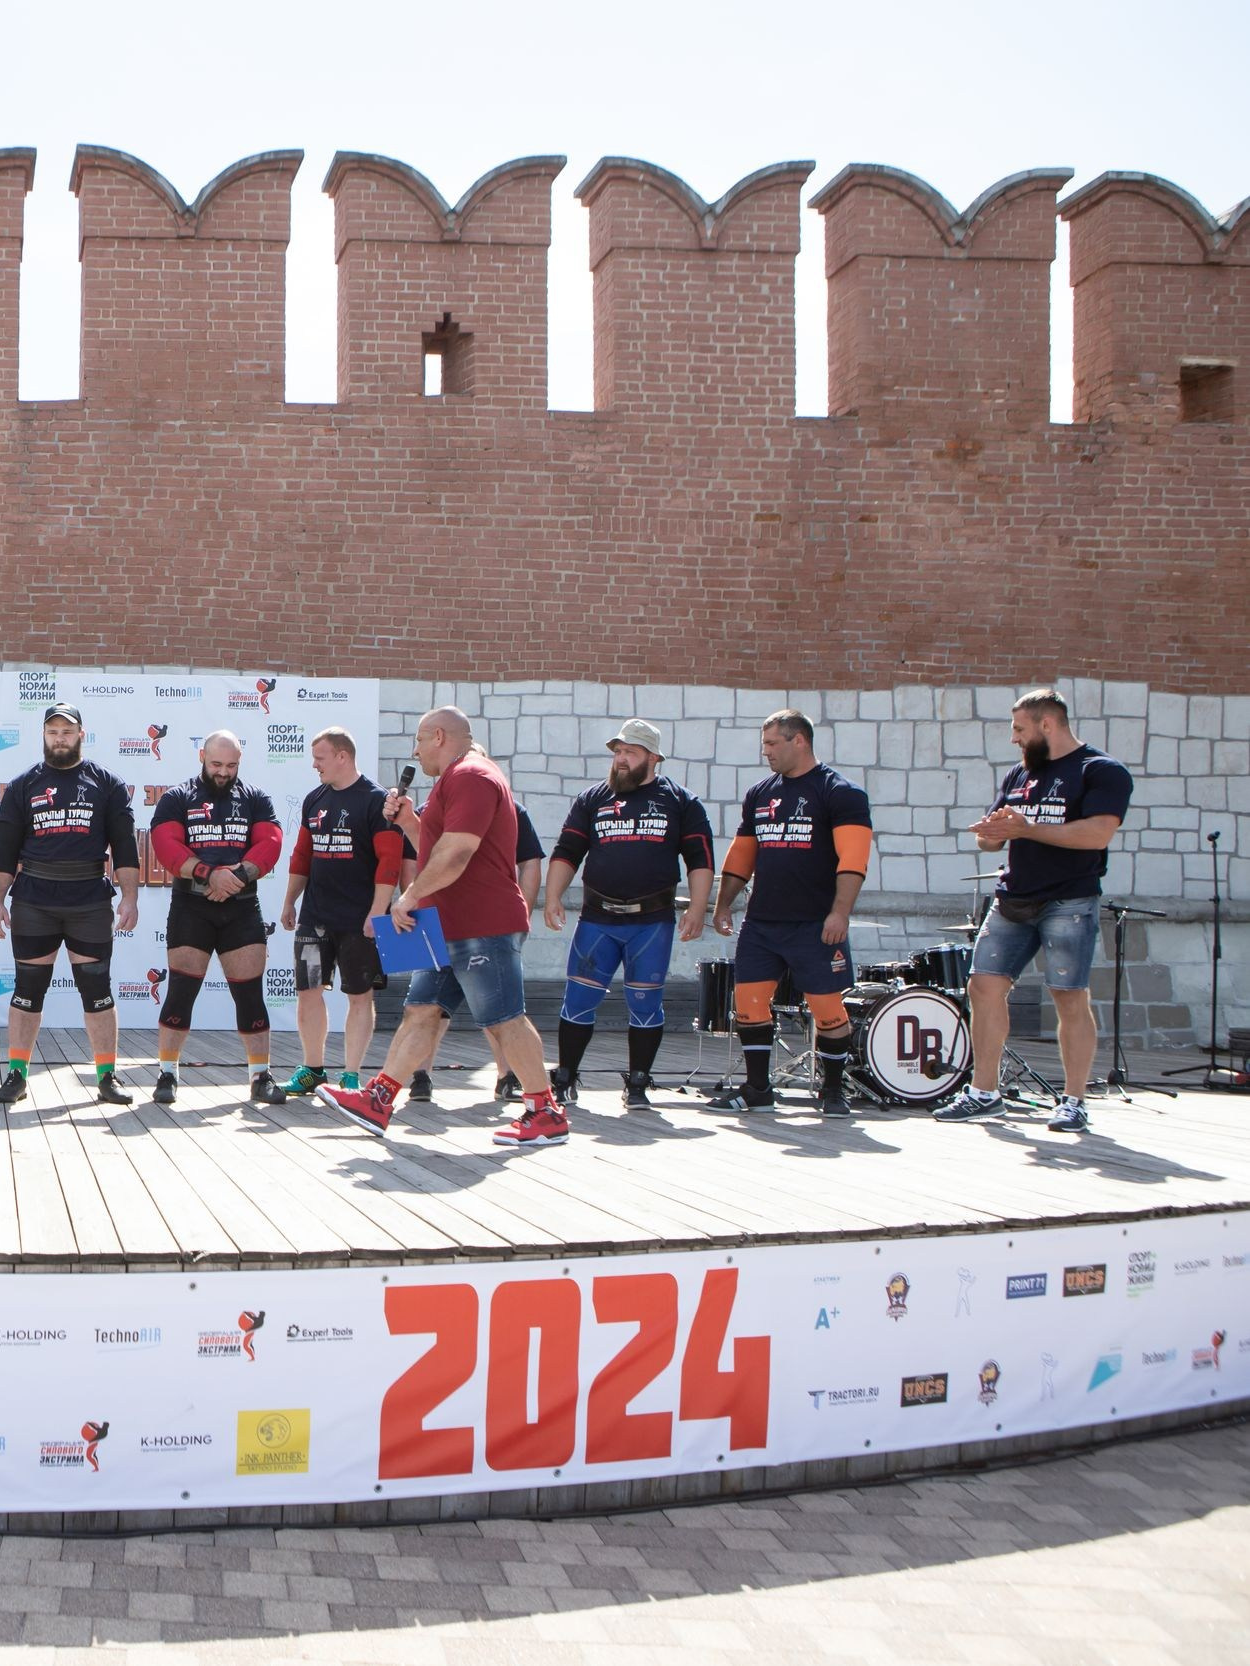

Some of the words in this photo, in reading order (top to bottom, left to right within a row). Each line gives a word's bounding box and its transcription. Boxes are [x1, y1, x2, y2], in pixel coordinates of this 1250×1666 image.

[18, 672, 49, 682] СПОРТ
[18, 682, 56, 691] НОРМА
[82, 686, 135, 695] K-HOLDING
[18, 691, 56, 700] ЖИЗНИ
[154, 686, 202, 698] TechnoAIR
[308, 691, 330, 699] Expert
[331, 691, 348, 699] Tools
[267, 724, 298, 734] СПОРТ
[267, 734, 305, 744] НОРМА
[118, 747, 150, 755] ЭКСТРИМА
[267, 743, 305, 753] ЖИЗНИ
[266, 978, 296, 988] НОРМ
[118, 991, 150, 999] ЭКСТРИМА
[1065, 1270, 1104, 1288] UNCS
[1008, 1277, 1036, 1292] PRINT
[1035, 1277, 1045, 1289] 71
[94, 1327, 162, 1344] TechnoAIR
[302, 1328, 329, 1340] Expert
[331, 1327, 353, 1337] Tools
[198, 1336, 241, 1346] СИЛОВОГО
[197, 1345, 241, 1354] ЭКСТРИМА
[378, 1267, 771, 1480] 2024
[904, 1379, 946, 1397] UNCS
[828, 1387, 880, 1401] TRACTORI.RU
[140, 1435, 213, 1447] K-HOLDING
[40, 1446, 84, 1455] СИЛОВОГО
[39, 1455, 85, 1464] ЭКСТРИМА
[244, 1453, 259, 1464] INK
[263, 1451, 302, 1462] PANTHER
